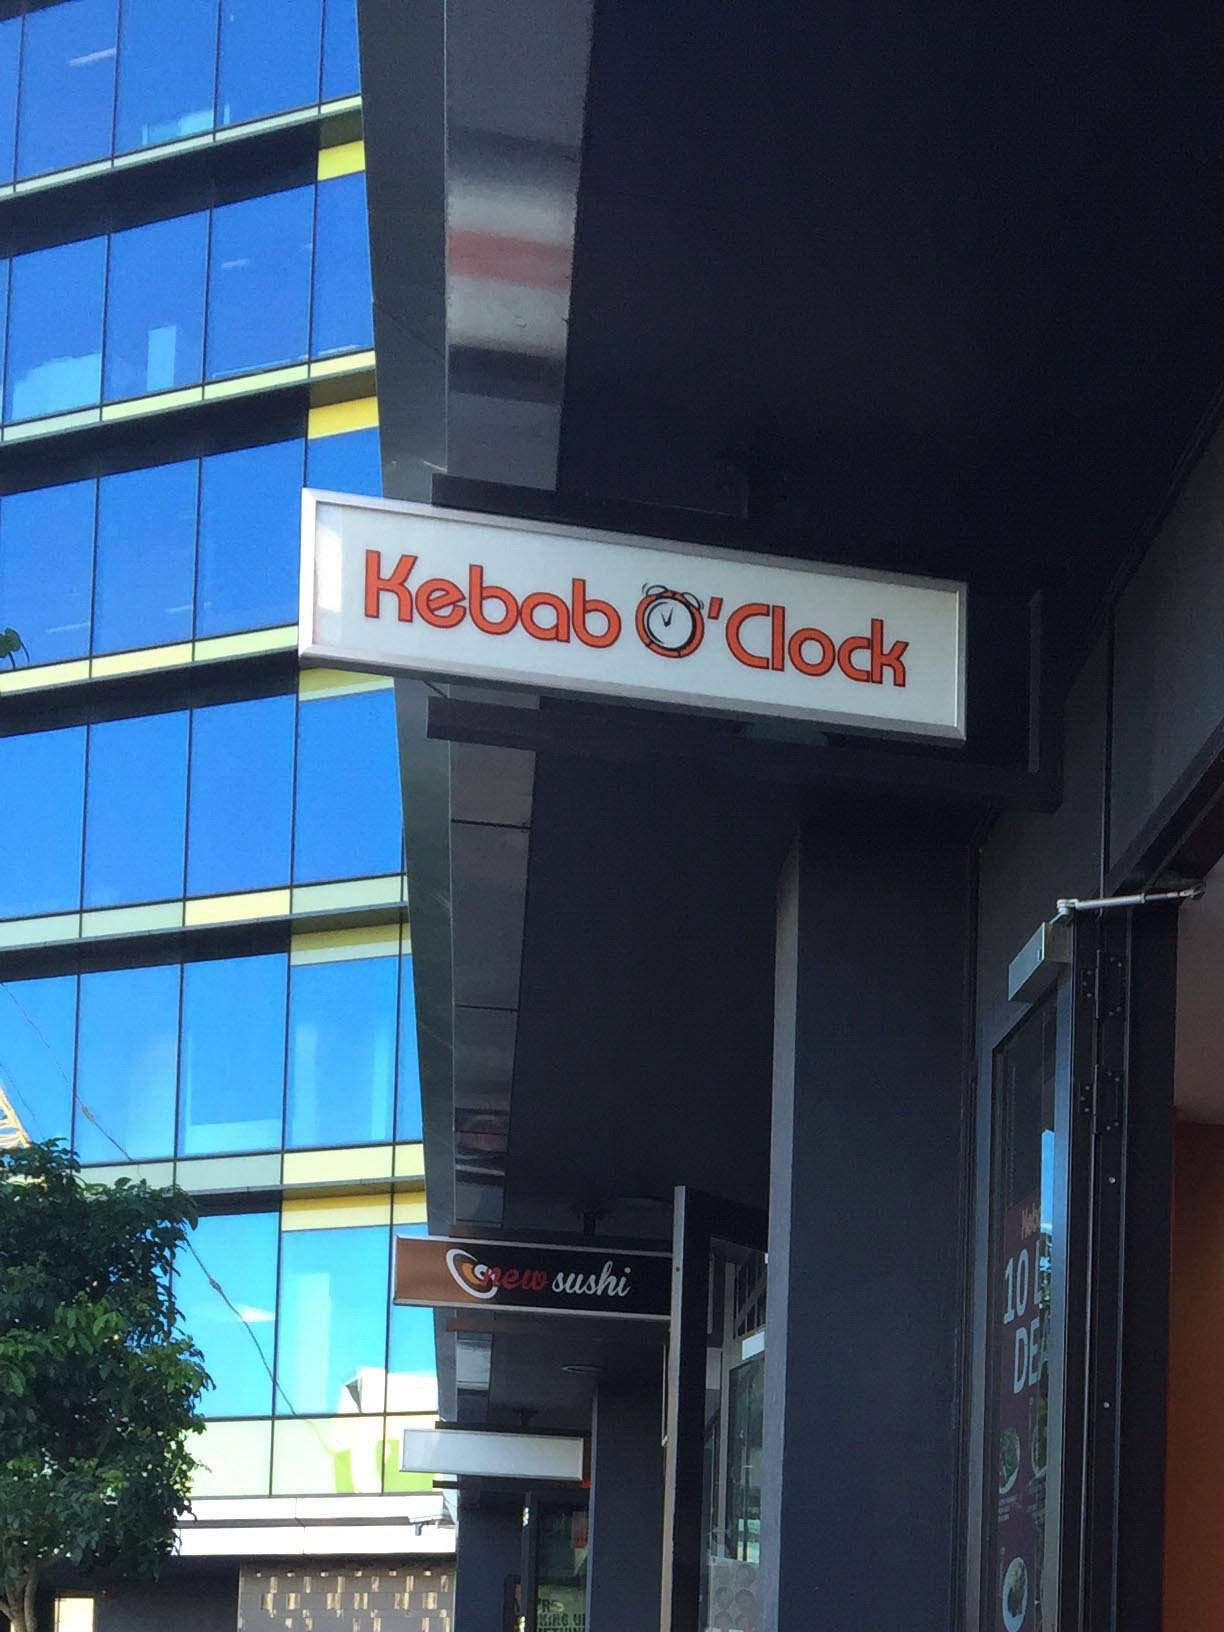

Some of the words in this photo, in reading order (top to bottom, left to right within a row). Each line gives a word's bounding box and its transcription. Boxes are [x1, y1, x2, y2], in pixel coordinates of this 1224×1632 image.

[363, 549, 622, 649] Kebab
[635, 584, 908, 688] O'Clock
[480, 1266, 548, 1291] new
[552, 1260, 632, 1297] sushi
[1003, 1248, 1028, 1324] 10
